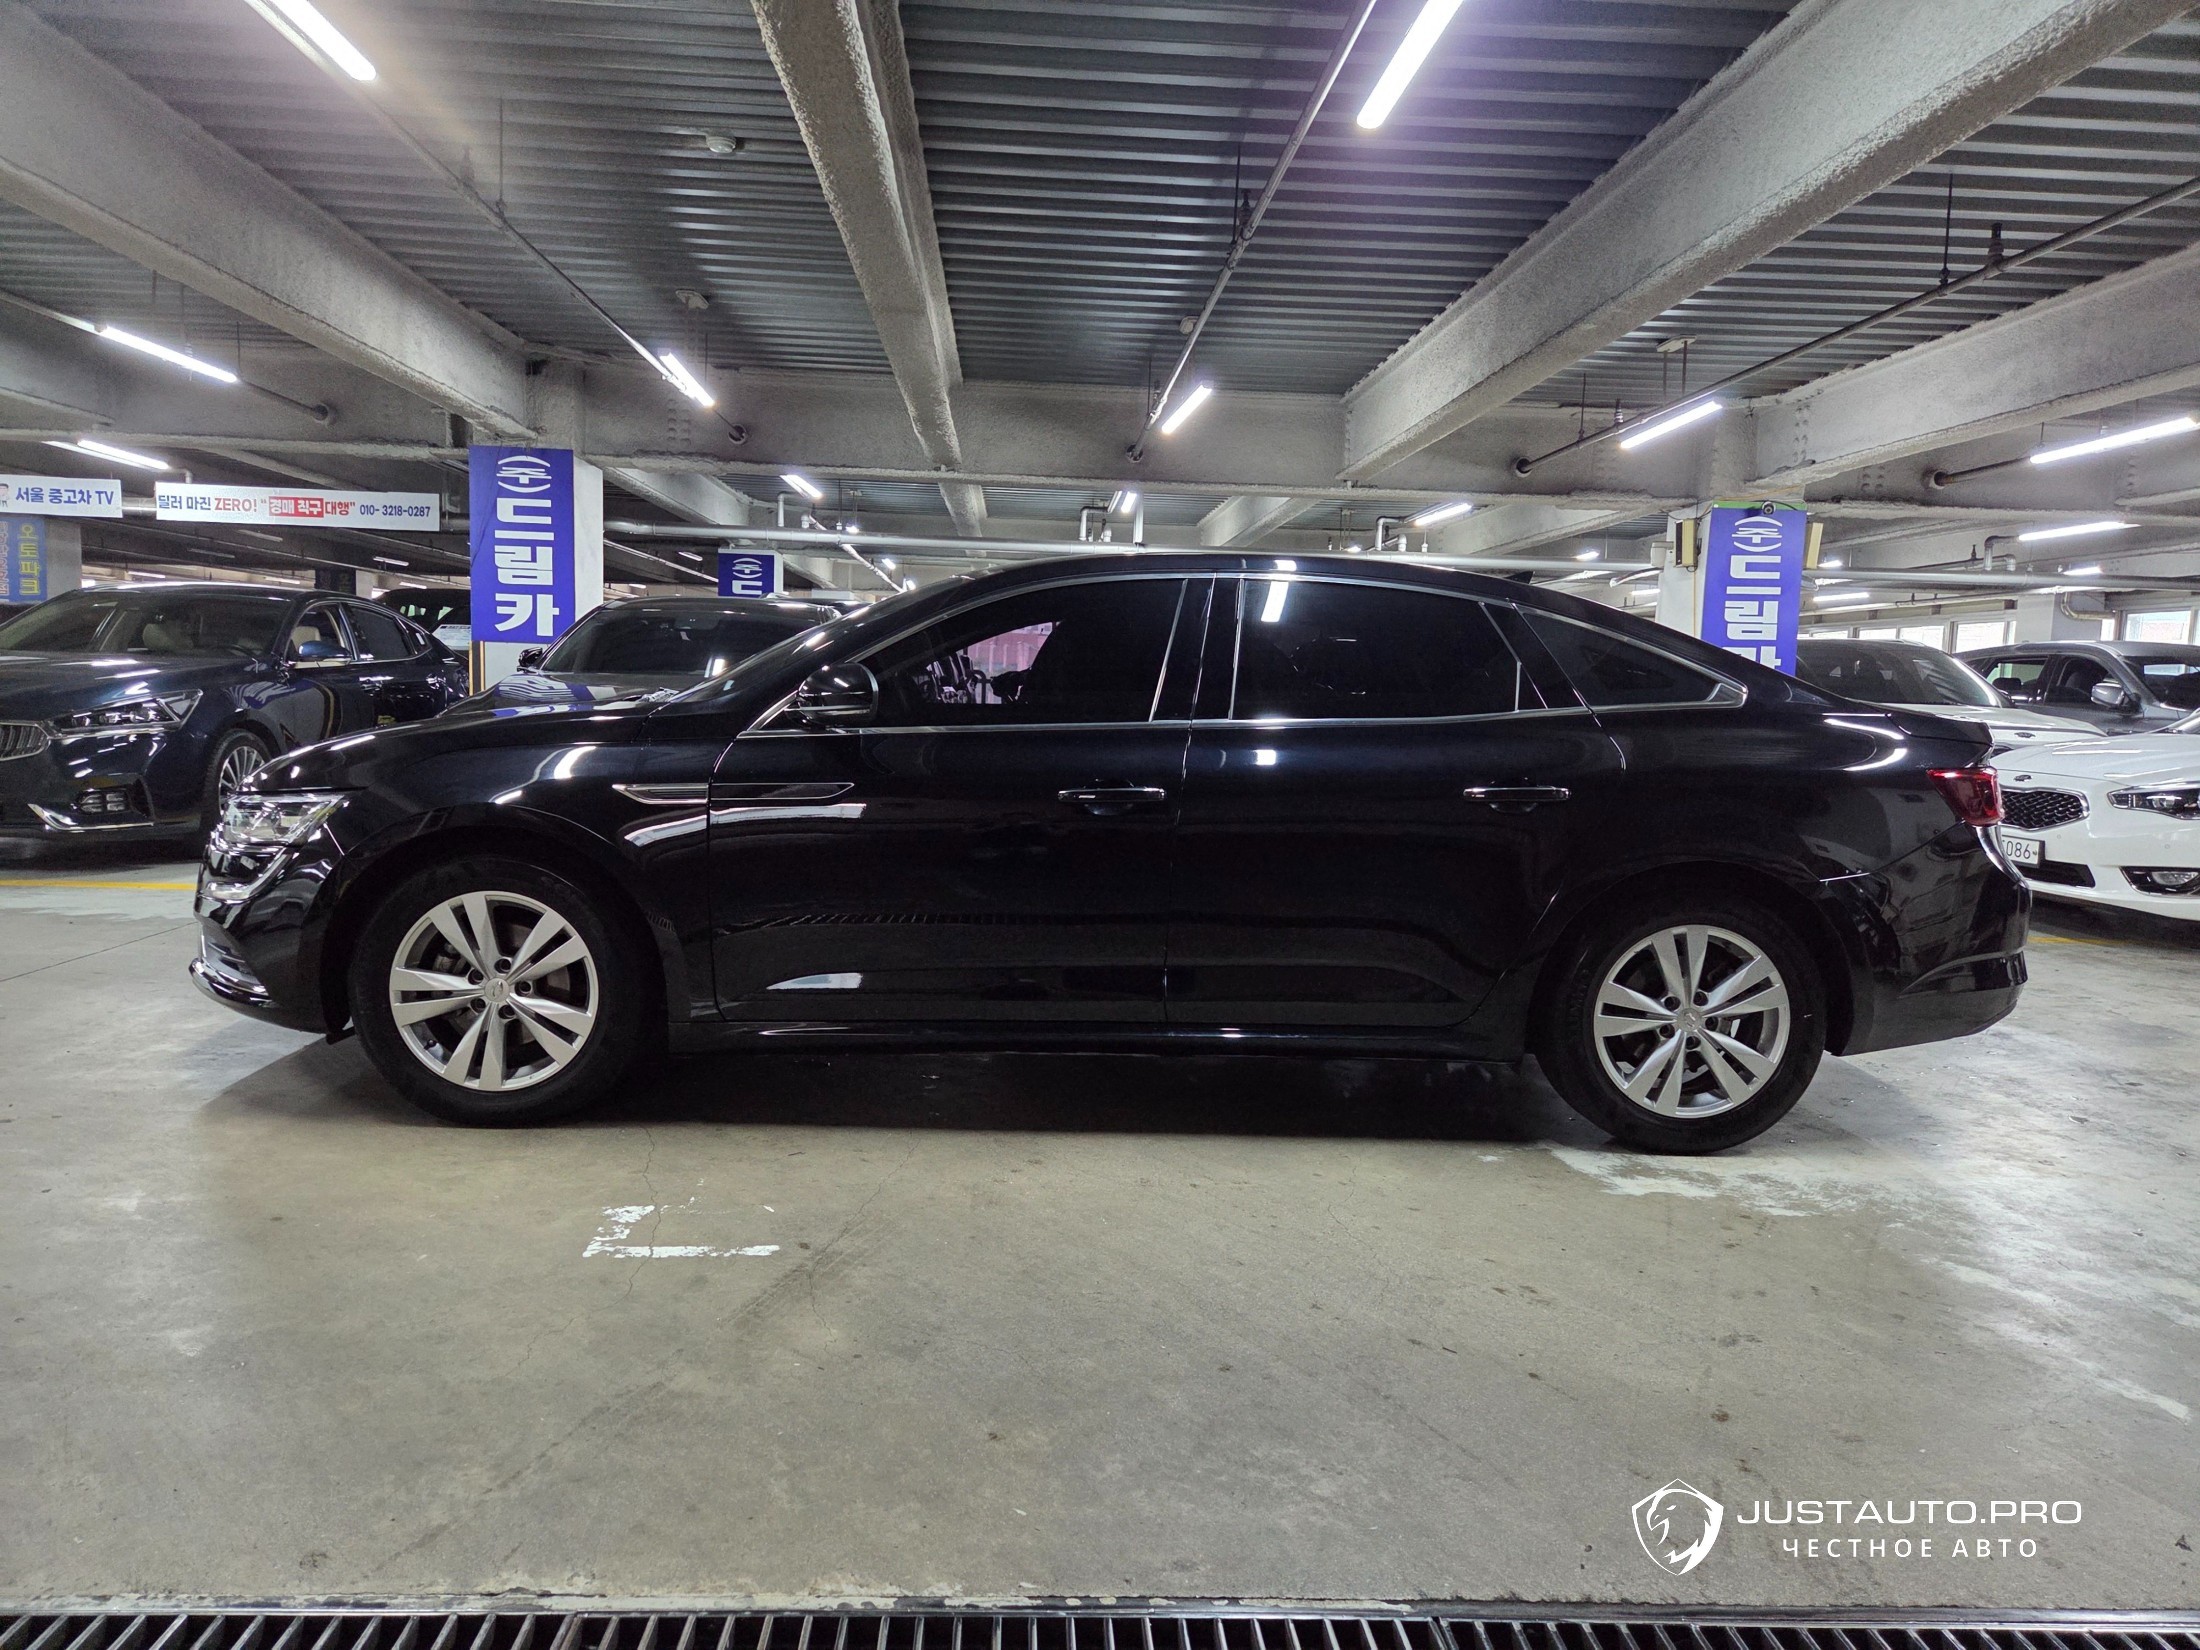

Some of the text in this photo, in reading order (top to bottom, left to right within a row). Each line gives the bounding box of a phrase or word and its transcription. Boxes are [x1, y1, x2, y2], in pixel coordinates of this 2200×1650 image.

[15, 486, 114, 505] 서울 중고차 TV
[158, 494, 182, 510] 딜러
[186, 496, 211, 511] 마진
[214, 497, 257, 513] ZERO!
[2002, 839, 2032, 860] 086
